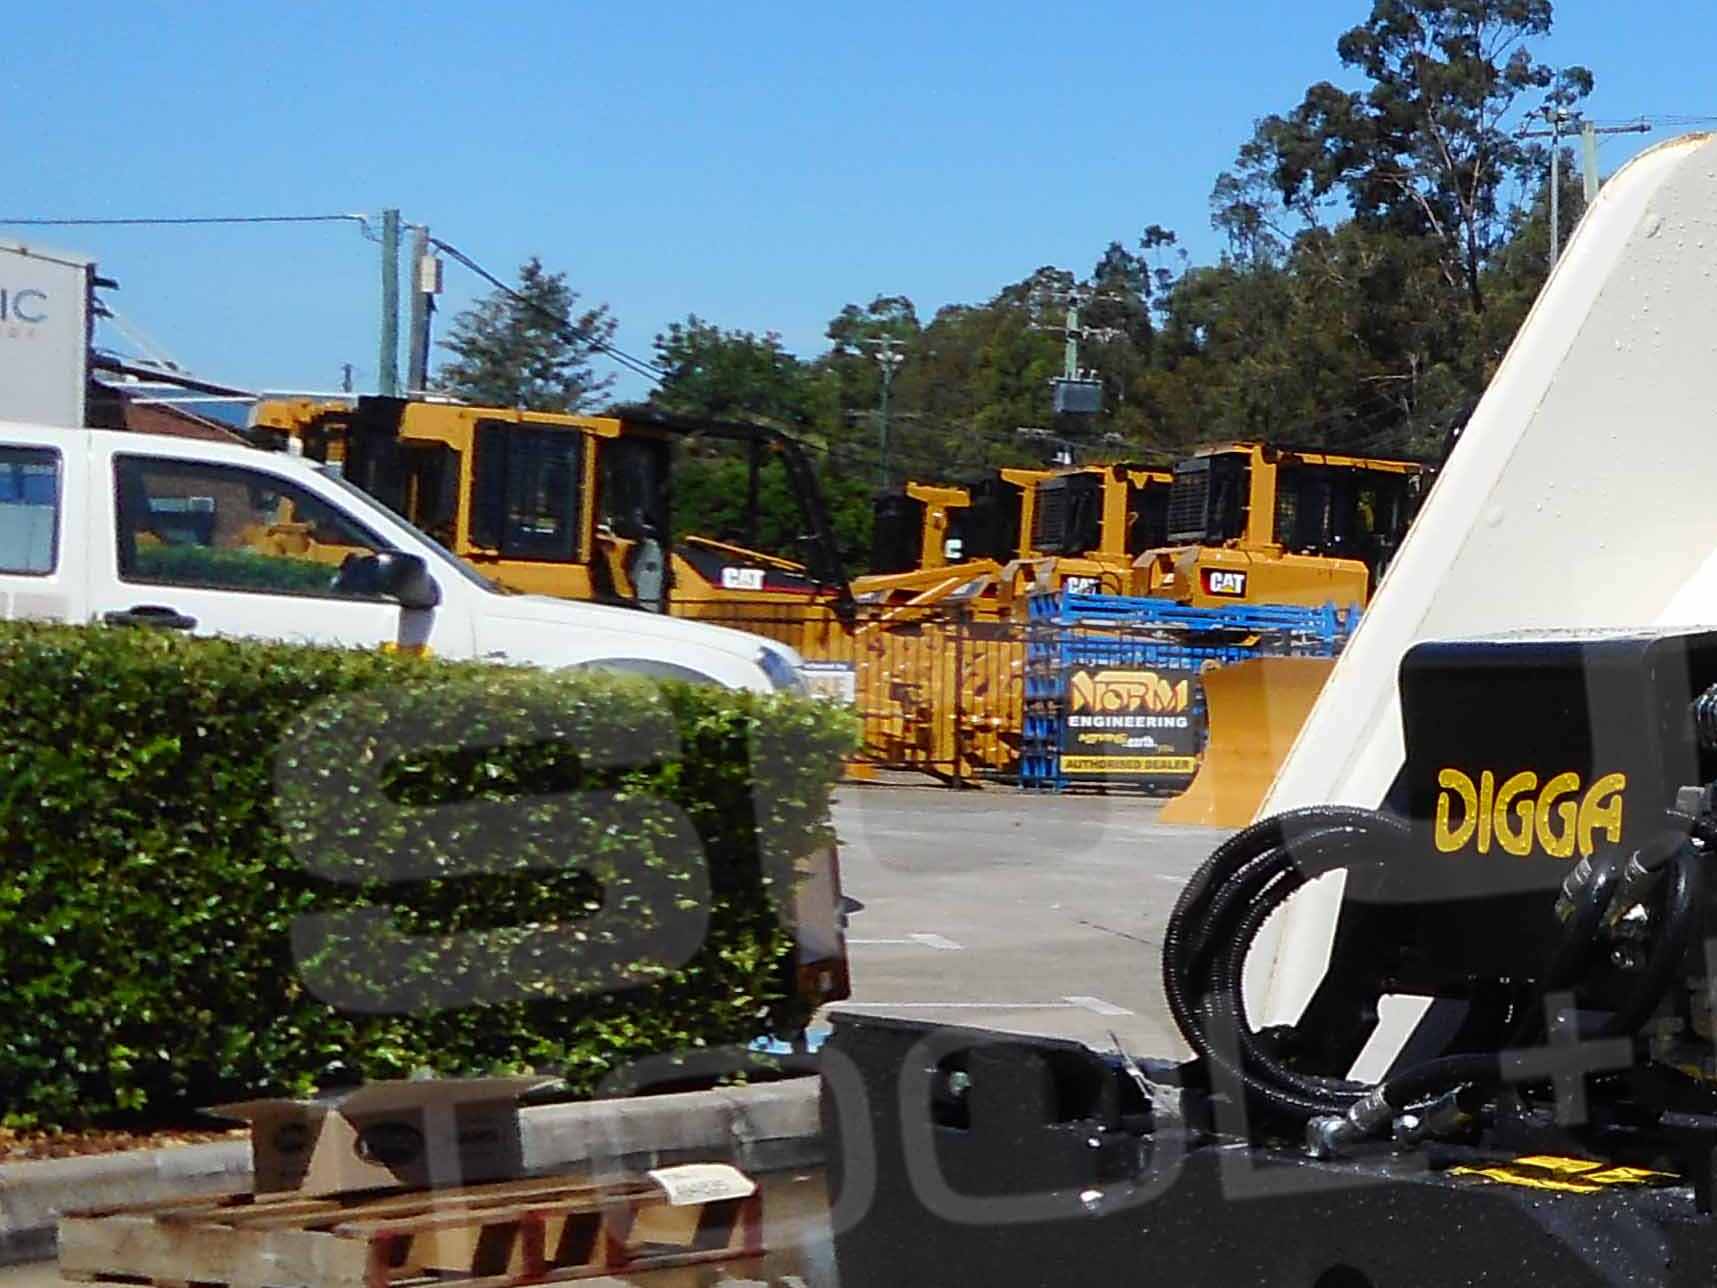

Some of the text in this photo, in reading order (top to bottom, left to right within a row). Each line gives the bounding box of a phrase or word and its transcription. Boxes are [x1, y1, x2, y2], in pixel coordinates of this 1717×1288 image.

[721, 568, 766, 589] CAT
[1209, 572, 1245, 594] CAT
[1070, 670, 1189, 713] NORM
[1067, 716, 1188, 728] ENGINEERING
[1145, 759, 1189, 769] DEALER
[1435, 768, 1626, 857] DIGGA
